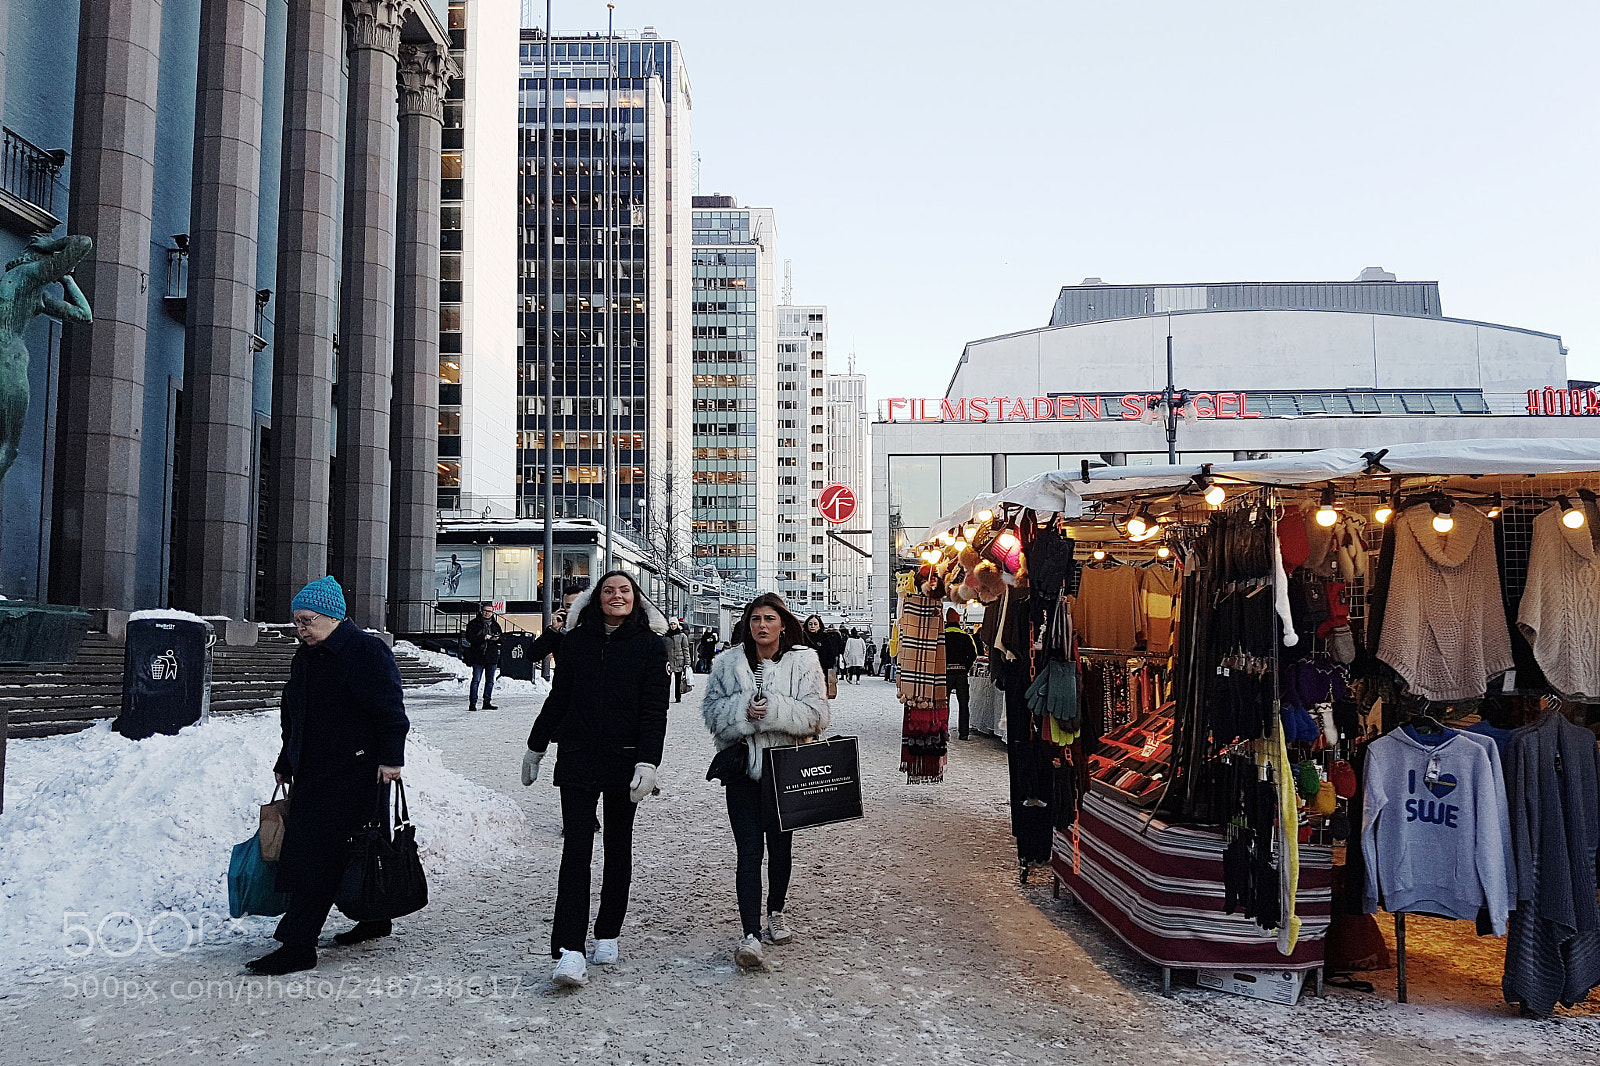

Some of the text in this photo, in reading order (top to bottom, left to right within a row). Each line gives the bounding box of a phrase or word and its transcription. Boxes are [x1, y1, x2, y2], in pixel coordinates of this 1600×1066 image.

[887, 396, 1101, 421] FILMSTADEN
[692, 583, 700, 593] 9
[1408, 769, 1416, 794] I
[1405, 798, 1459, 829] SWE
